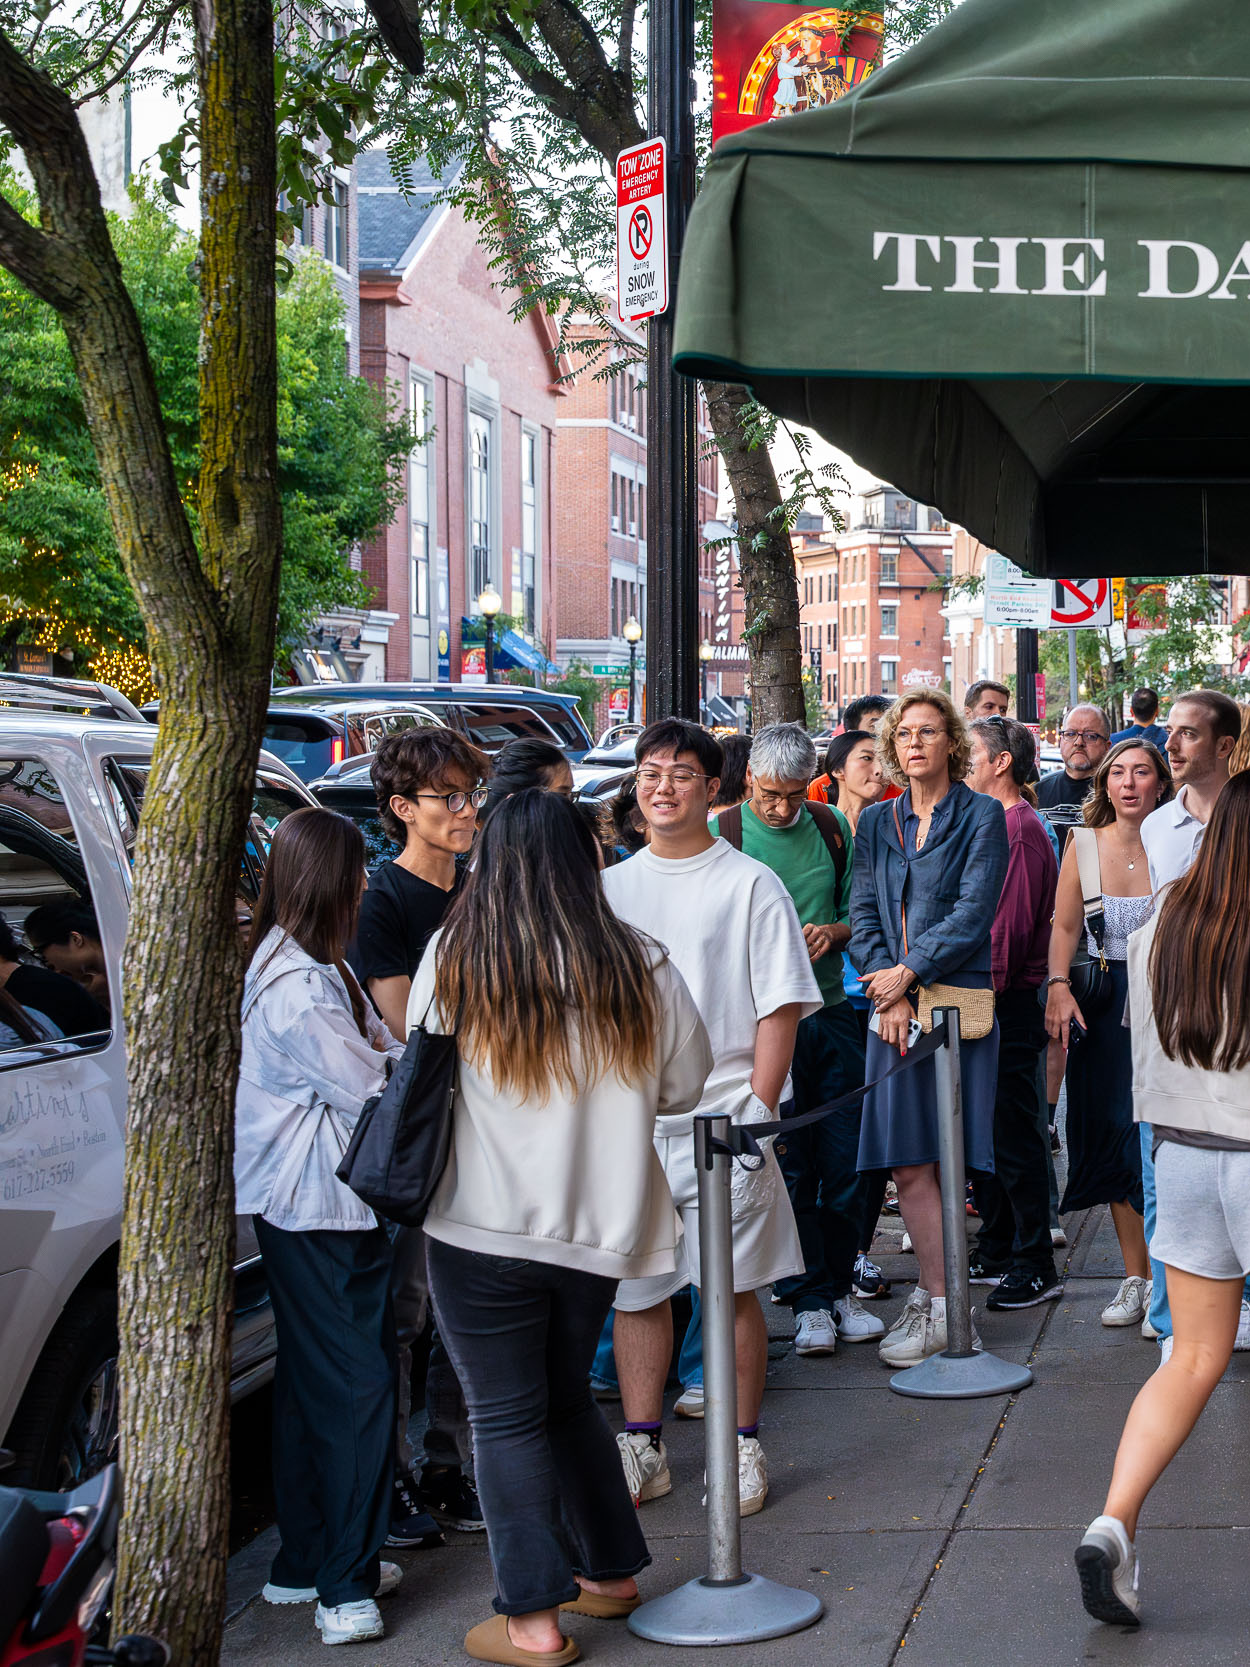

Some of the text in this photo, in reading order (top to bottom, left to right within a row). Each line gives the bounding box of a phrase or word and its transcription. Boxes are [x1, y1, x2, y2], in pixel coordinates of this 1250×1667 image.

[620, 148, 661, 178] TOW ZONE
[621, 169, 659, 190] EMERGENCY
[628, 184, 652, 201] ARTERY
[633, 260, 650, 271] during
[874, 232, 1106, 297] THE
[628, 271, 655, 292] SNOW
[625, 290, 659, 307] EMERGENCY
[715, 546, 731, 642] CANTINA
[709, 646, 749, 660] TALIANA
